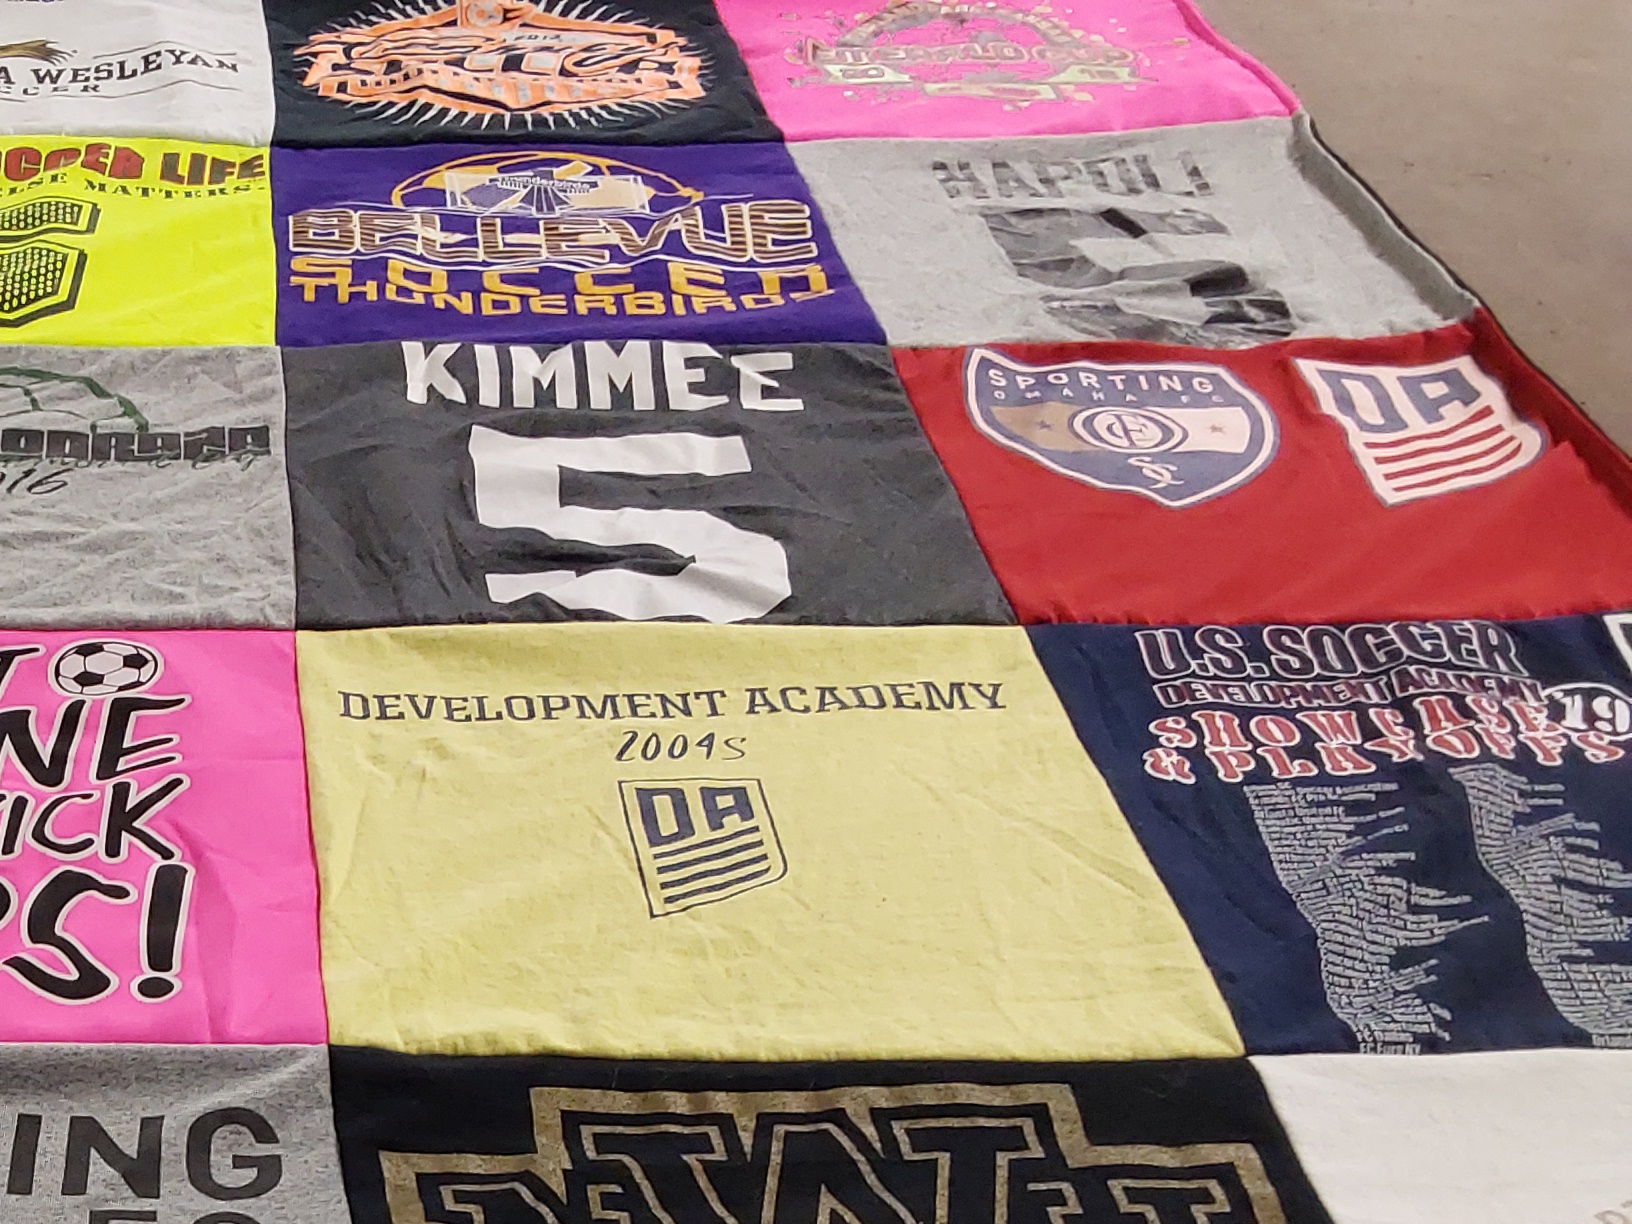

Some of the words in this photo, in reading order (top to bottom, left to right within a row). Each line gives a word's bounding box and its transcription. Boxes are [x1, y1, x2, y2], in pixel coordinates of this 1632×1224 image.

[32, 48, 242, 86] WESLEYAN
[159, 152, 267, 187] LIFE
[288, 199, 819, 264] BELLEVUE
[401, 340, 806, 412] KIMMEE
[986, 367, 1216, 394] SPORTING
[468, 424, 793, 626] 5
[1135, 626, 1270, 679] U.S.
[1264, 620, 1529, 678] SOCCER
[338, 688, 730, 723] DEVELOPMENT
[743, 680, 1008, 716] ACADEMY
[1152, 679, 1392, 708] DEVELOPMENT
[1390, 665, 1546, 704] ACADEMY
[1148, 694, 1563, 750] SHOWCASE
[635, 786, 756, 849] DA
